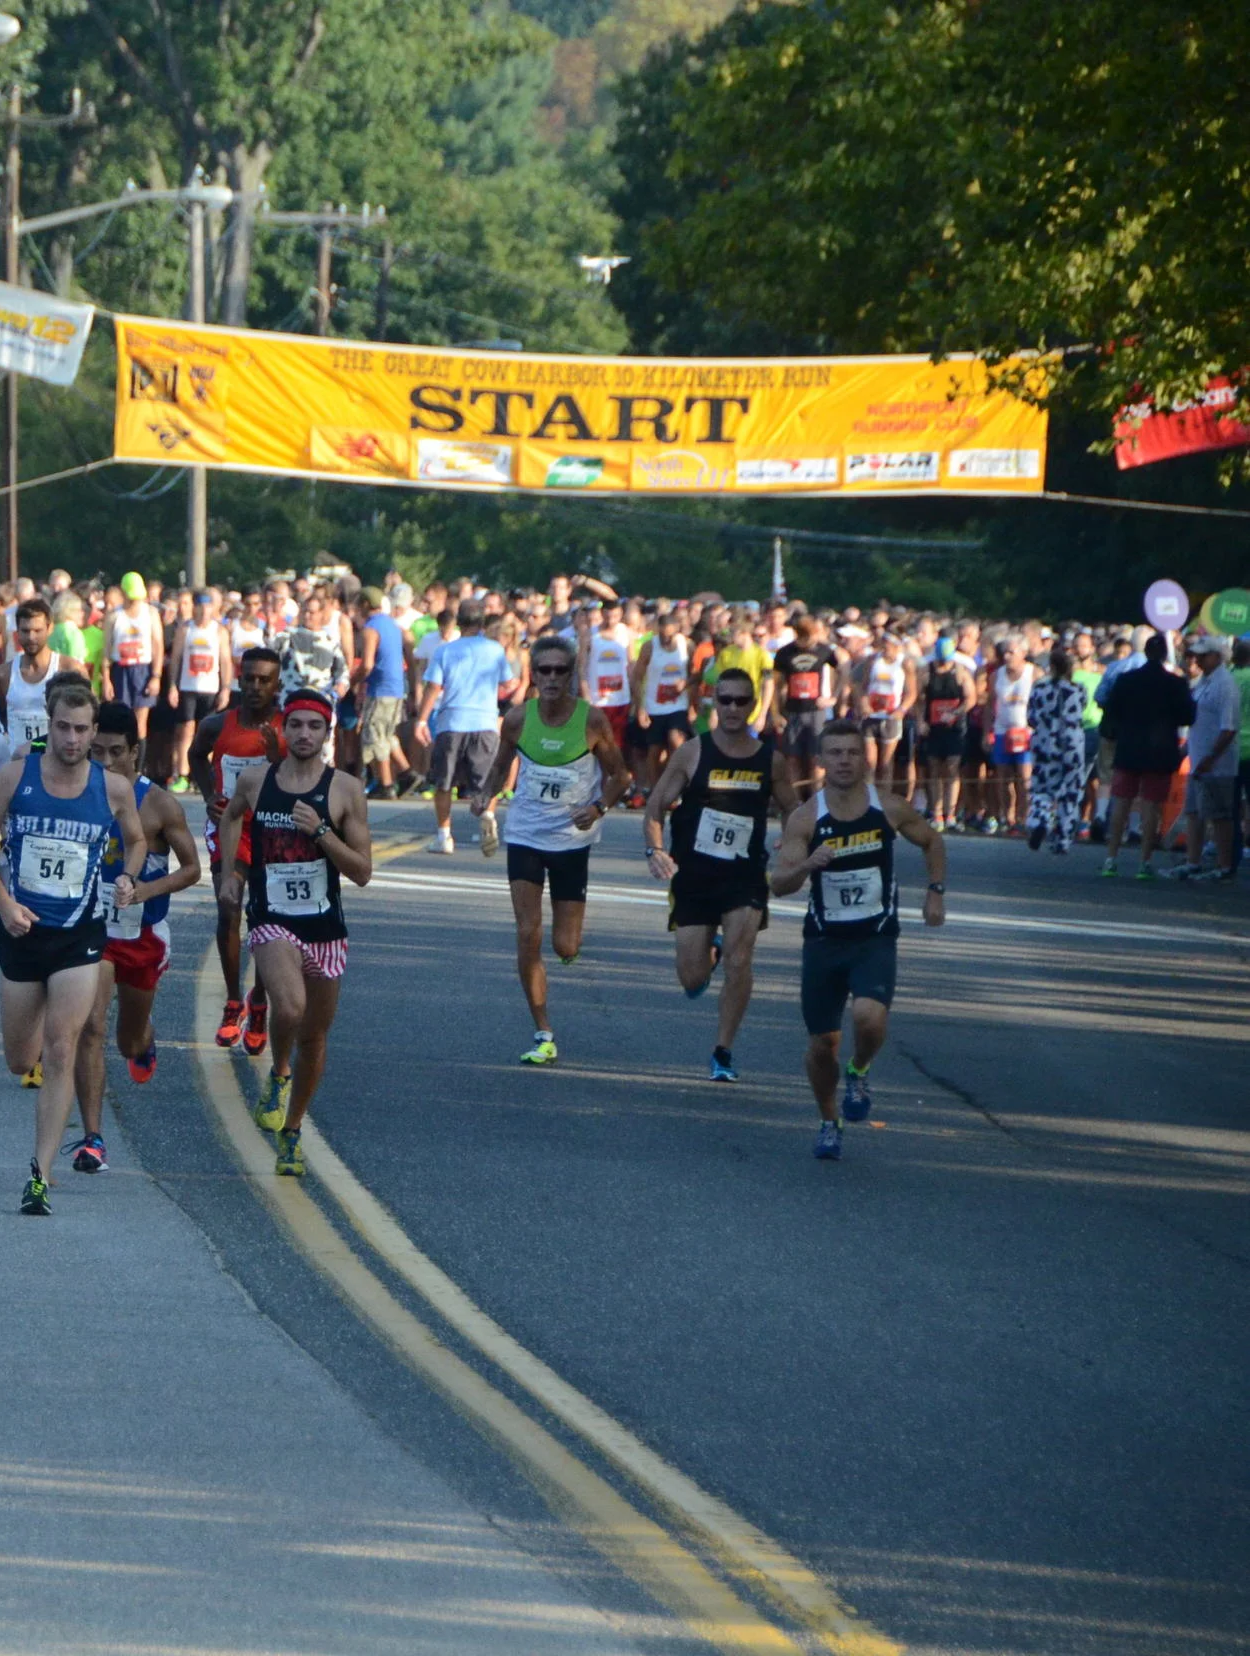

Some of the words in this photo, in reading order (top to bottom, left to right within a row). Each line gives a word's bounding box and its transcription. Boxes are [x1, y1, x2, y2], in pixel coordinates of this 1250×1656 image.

[31, 314, 78, 345] 12
[330, 349, 373, 372] THE
[384, 354, 454, 378] GREAT
[462, 360, 511, 382] COW
[517, 363, 607, 387] HARBOR
[642, 366, 775, 388] KILOMETER
[782, 366, 833, 388] RUN
[410, 384, 750, 443] START
[25, 725, 41, 741] 61
[709, 768, 763, 785] GLIRC
[540, 782, 561, 799] 76
[713, 826, 735, 847] 69
[39, 858, 66, 881] 54
[285, 880, 312, 901] 53
[840, 886, 864, 907] 62
